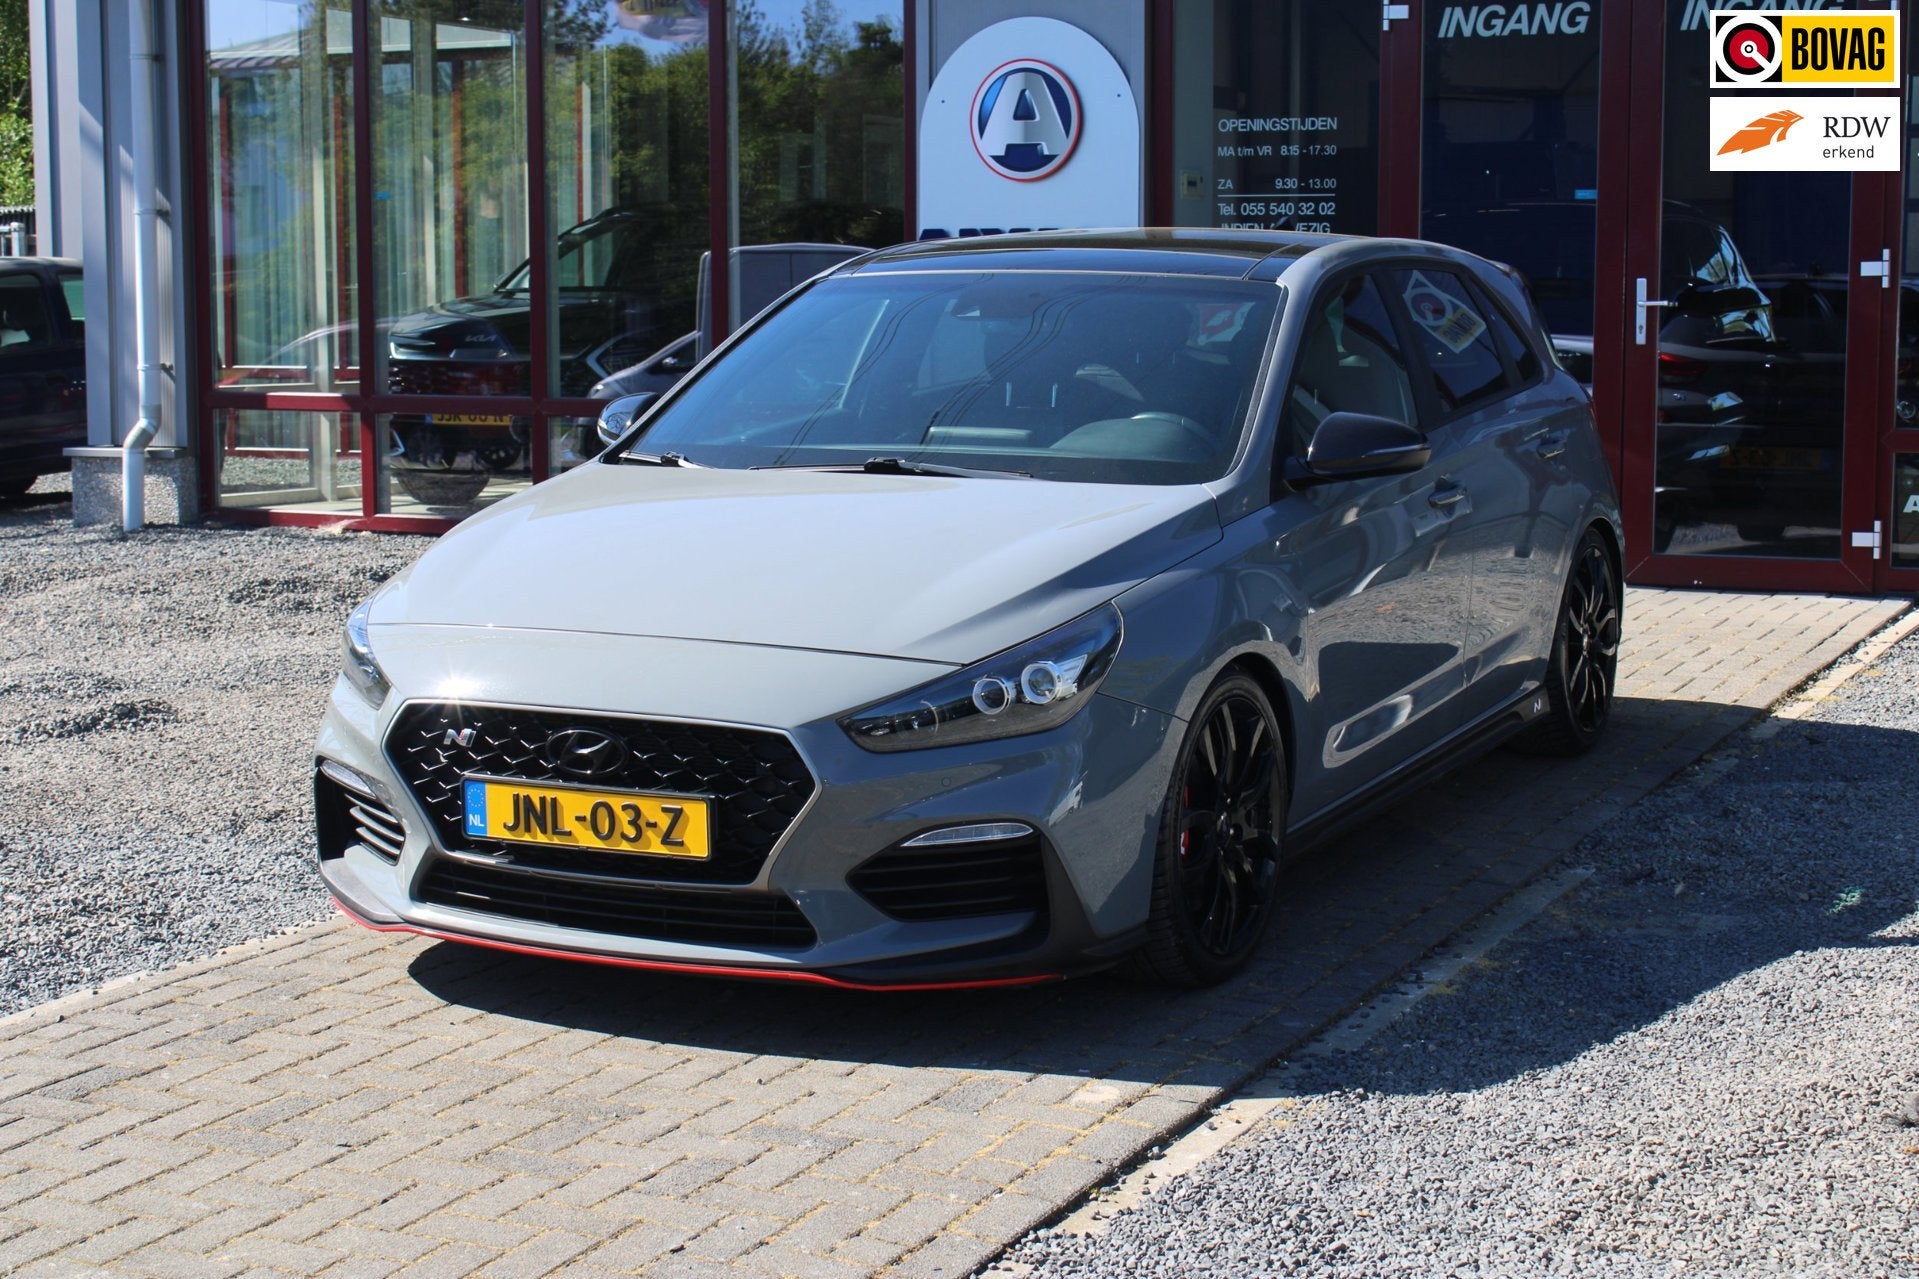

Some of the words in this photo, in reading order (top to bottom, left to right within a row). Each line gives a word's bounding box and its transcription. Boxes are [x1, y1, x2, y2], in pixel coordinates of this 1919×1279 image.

[1437, 1, 1591, 38] INGANG
[1218, 117, 1337, 132] OPENINGSTIJDEN
[1217, 146, 1235, 156] MA
[1238, 146, 1254, 156] t/m
[1257, 146, 1272, 156] VR
[1280, 145, 1299, 156] 8.15
[1309, 145, 1337, 155] 17.30
[1217, 179, 1234, 189] ZA
[1275, 178, 1298, 189] 9.30
[1309, 178, 1337, 189] 13.00
[1217, 203, 1236, 216] Tel.
[1240, 203, 1265, 215] 055
[1269, 202, 1295, 215] 540
[1298, 202, 1315, 215] 32
[1318, 202, 1335, 215] 02
[443, 728, 477, 748] N
[469, 813, 485, 827] NL
[503, 792, 685, 847] JNL-03-Z
